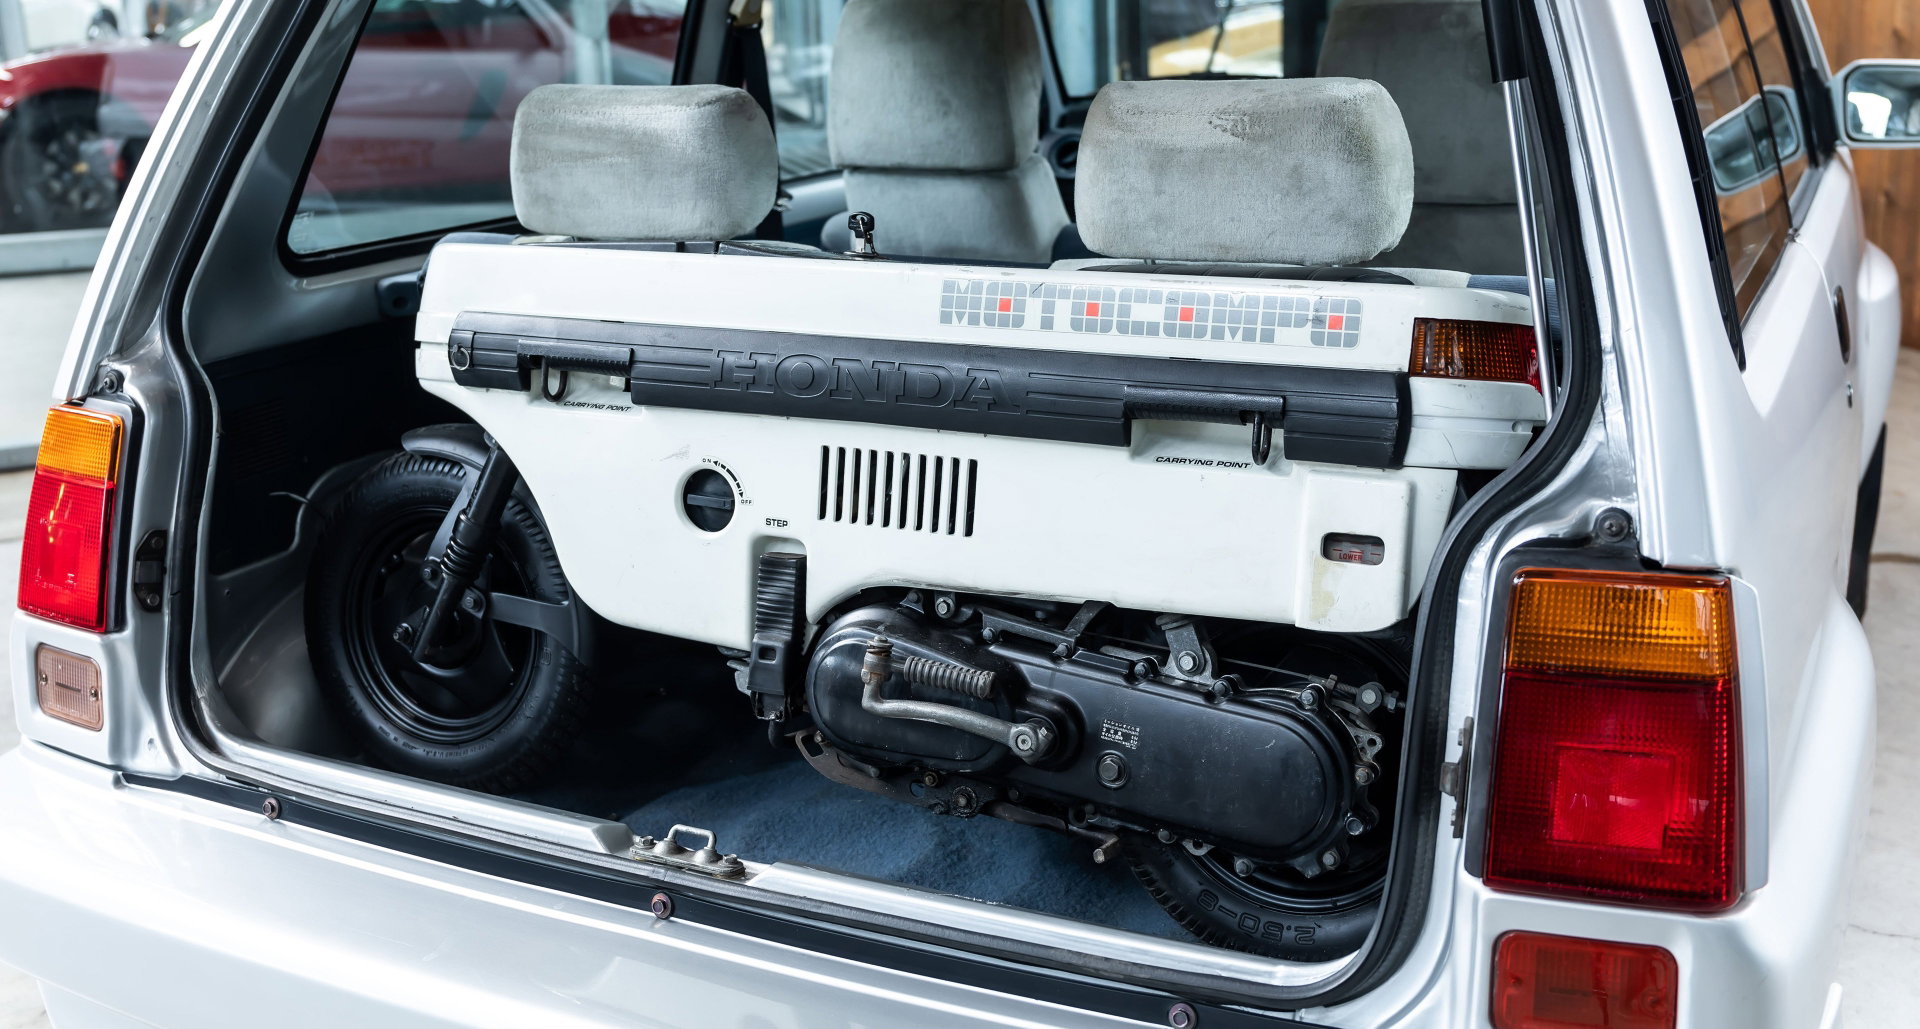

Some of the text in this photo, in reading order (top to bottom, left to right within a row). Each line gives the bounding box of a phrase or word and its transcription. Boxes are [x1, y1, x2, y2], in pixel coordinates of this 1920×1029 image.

[940, 279, 1362, 349] MOTOCOMPO
[714, 350, 1021, 415] HONDA
[563, 401, 605, 409] CARRYING
[1155, 456, 1251, 469] CARRYING POINT
[765, 517, 789, 528] STEP
[1338, 552, 1364, 561] LOWER
[1198, 888, 1316, 946] 2.50-8
